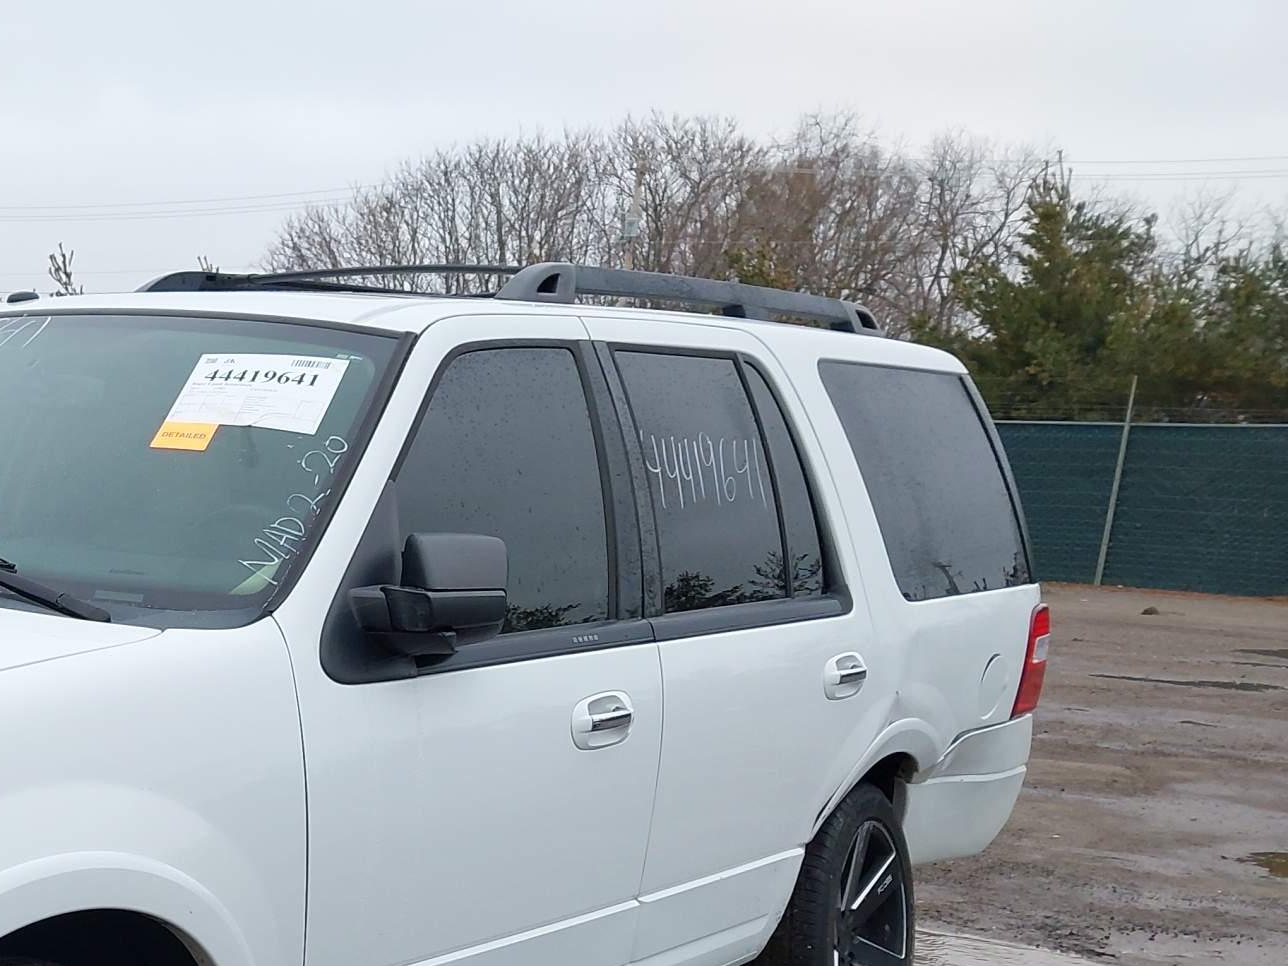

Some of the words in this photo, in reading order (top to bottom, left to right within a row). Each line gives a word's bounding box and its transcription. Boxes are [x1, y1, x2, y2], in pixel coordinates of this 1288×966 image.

[204, 368, 320, 387] 44419641
[161, 431, 207, 440] DETAILED
[639, 429, 768, 509] 44419641
